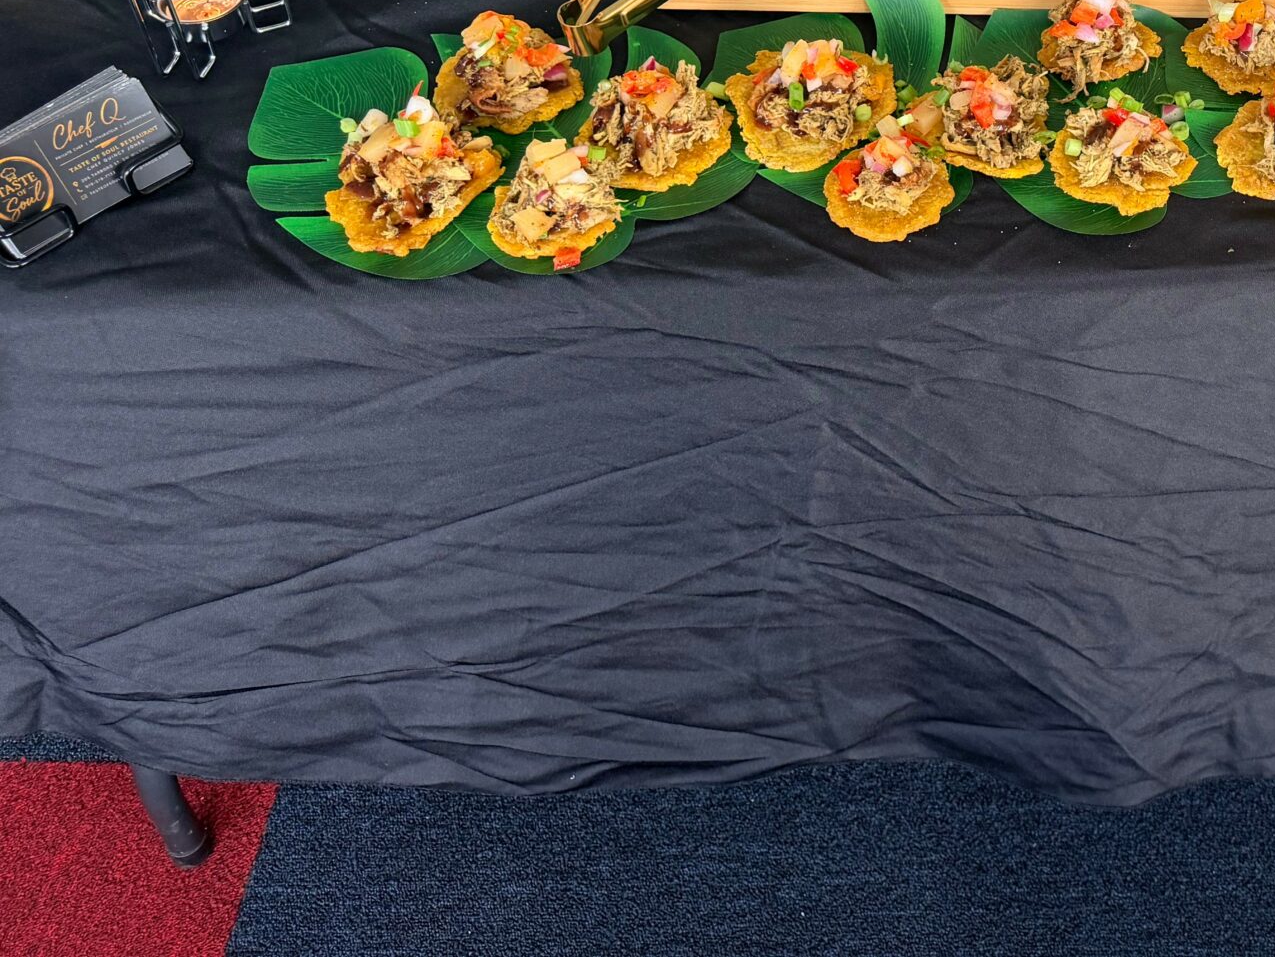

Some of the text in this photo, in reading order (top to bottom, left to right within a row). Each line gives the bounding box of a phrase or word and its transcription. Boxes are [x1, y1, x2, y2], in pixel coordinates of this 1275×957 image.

[52, 97, 127, 150] Chef Q
[68, 159, 91, 174] TASTE
[91, 153, 101, 162] OF
[101, 145, 120, 157] SOUL
[120, 125, 159, 148] RESTAURANT
[86, 160, 102, 172] CHEF
[102, 148, 125, 163] QUINCY
[126, 139, 146, 152] JONES
[6, 179, 46, 223] Soul
